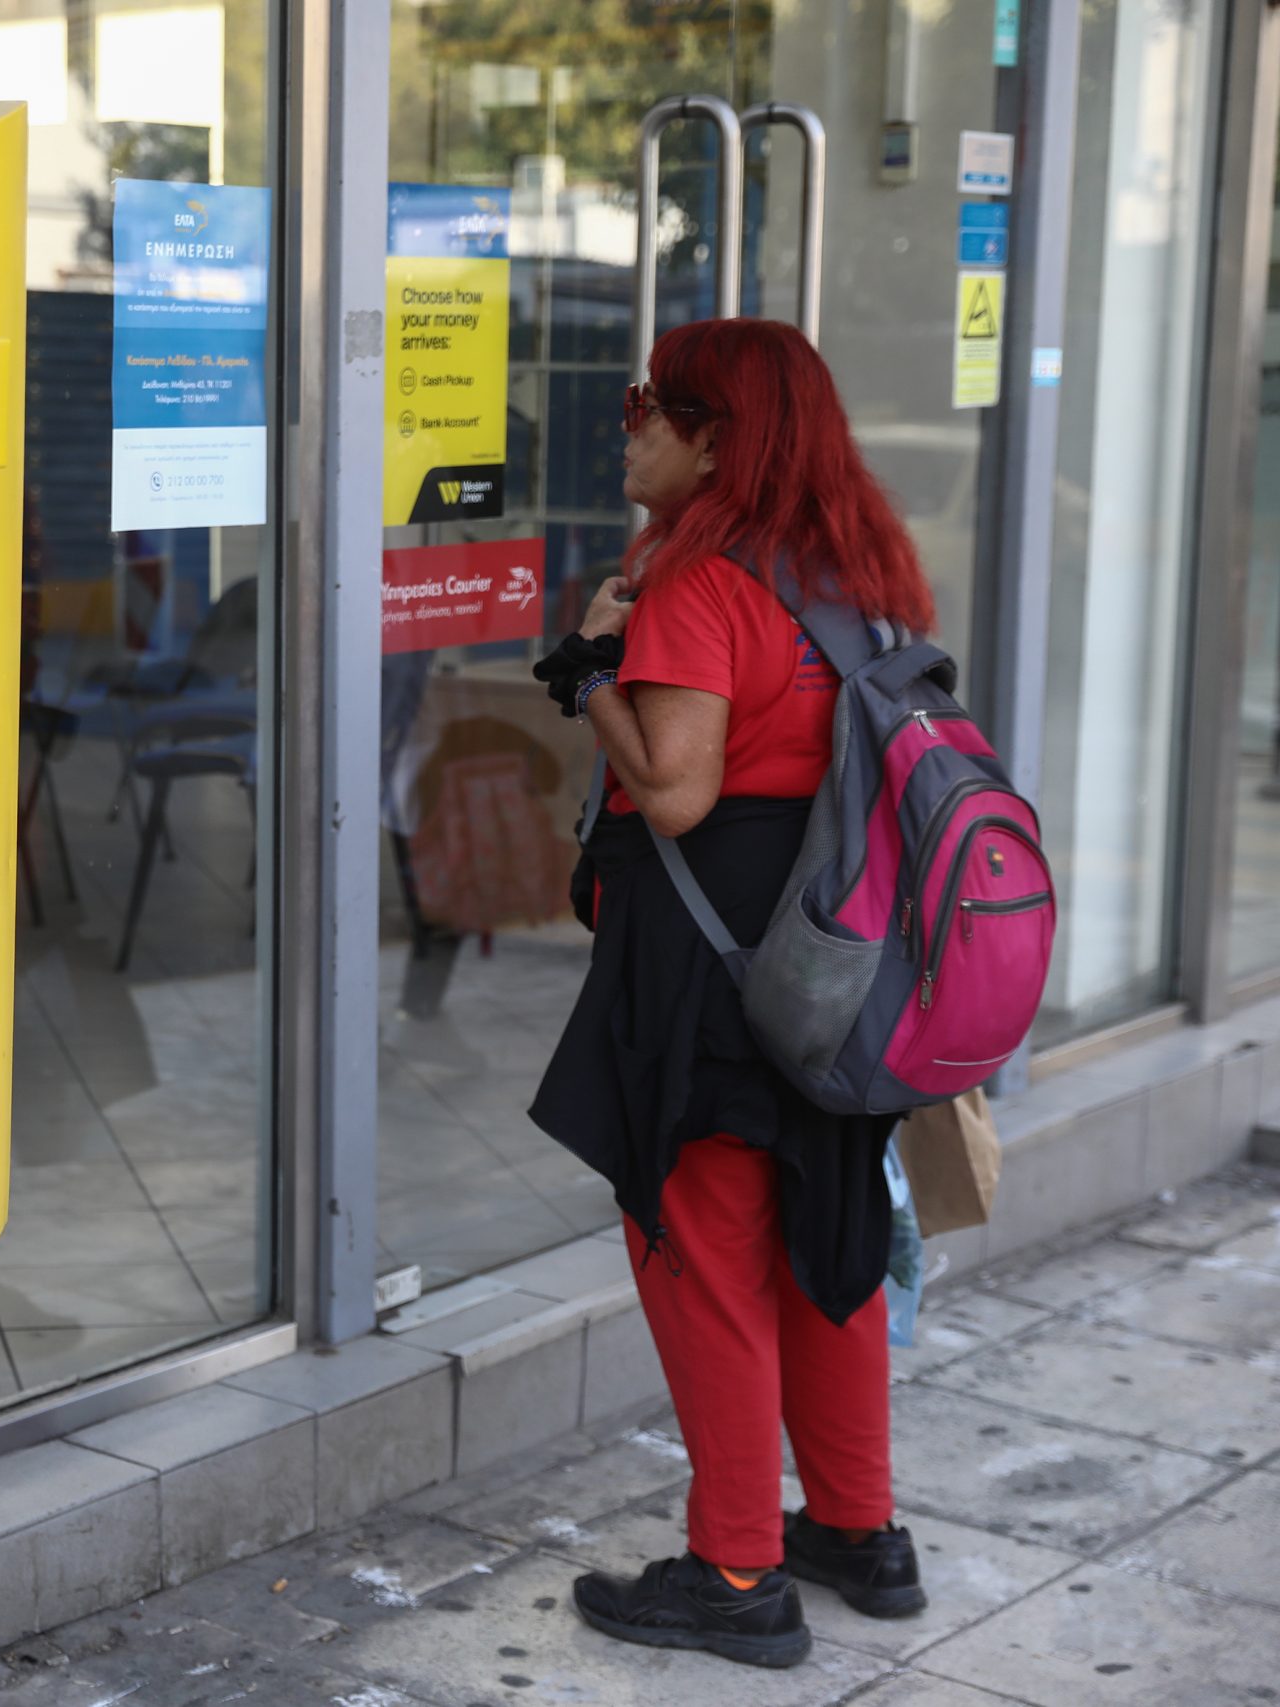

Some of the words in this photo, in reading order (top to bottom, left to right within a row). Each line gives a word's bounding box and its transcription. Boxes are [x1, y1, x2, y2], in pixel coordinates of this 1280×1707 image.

[174, 214, 195, 227] ΕΛΤΑ
[146, 242, 235, 259] ΕΝΗΜΕΡΩΣΗ
[402, 287, 452, 304] Choose
[455, 288, 484, 304] how
[401, 313, 431, 331] your
[433, 314, 480, 331] money
[401, 334, 452, 350] arrives:
[422, 375, 442, 386] Cash
[445, 375, 475, 387] Pickup
[422, 417, 442, 429] Bank
[462, 481, 493, 492] Western
[461, 493, 484, 504] Union
[445, 573, 493, 595] Courier
